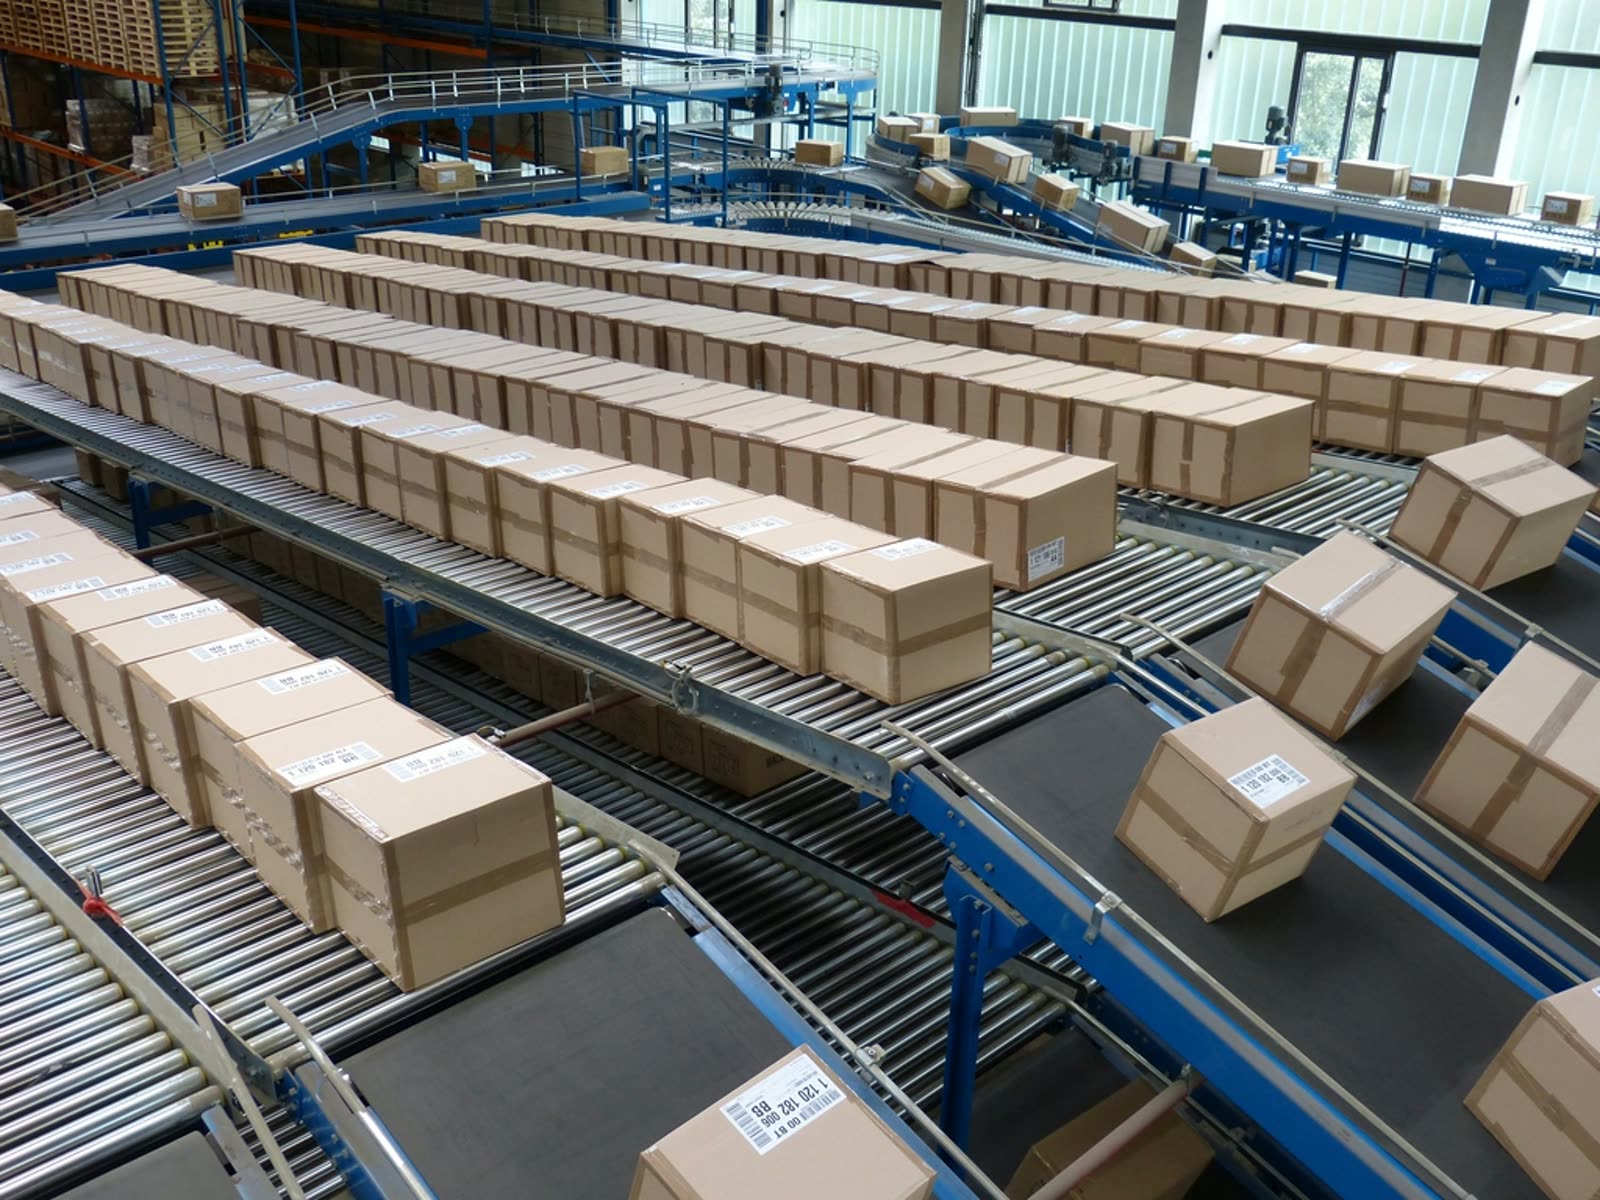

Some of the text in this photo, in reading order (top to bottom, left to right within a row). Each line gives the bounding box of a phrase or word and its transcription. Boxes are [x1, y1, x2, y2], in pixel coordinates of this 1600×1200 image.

[797, 1083, 820, 1103] 120
[817, 1078, 829, 1089] 1
[777, 1096, 800, 1116] 182
